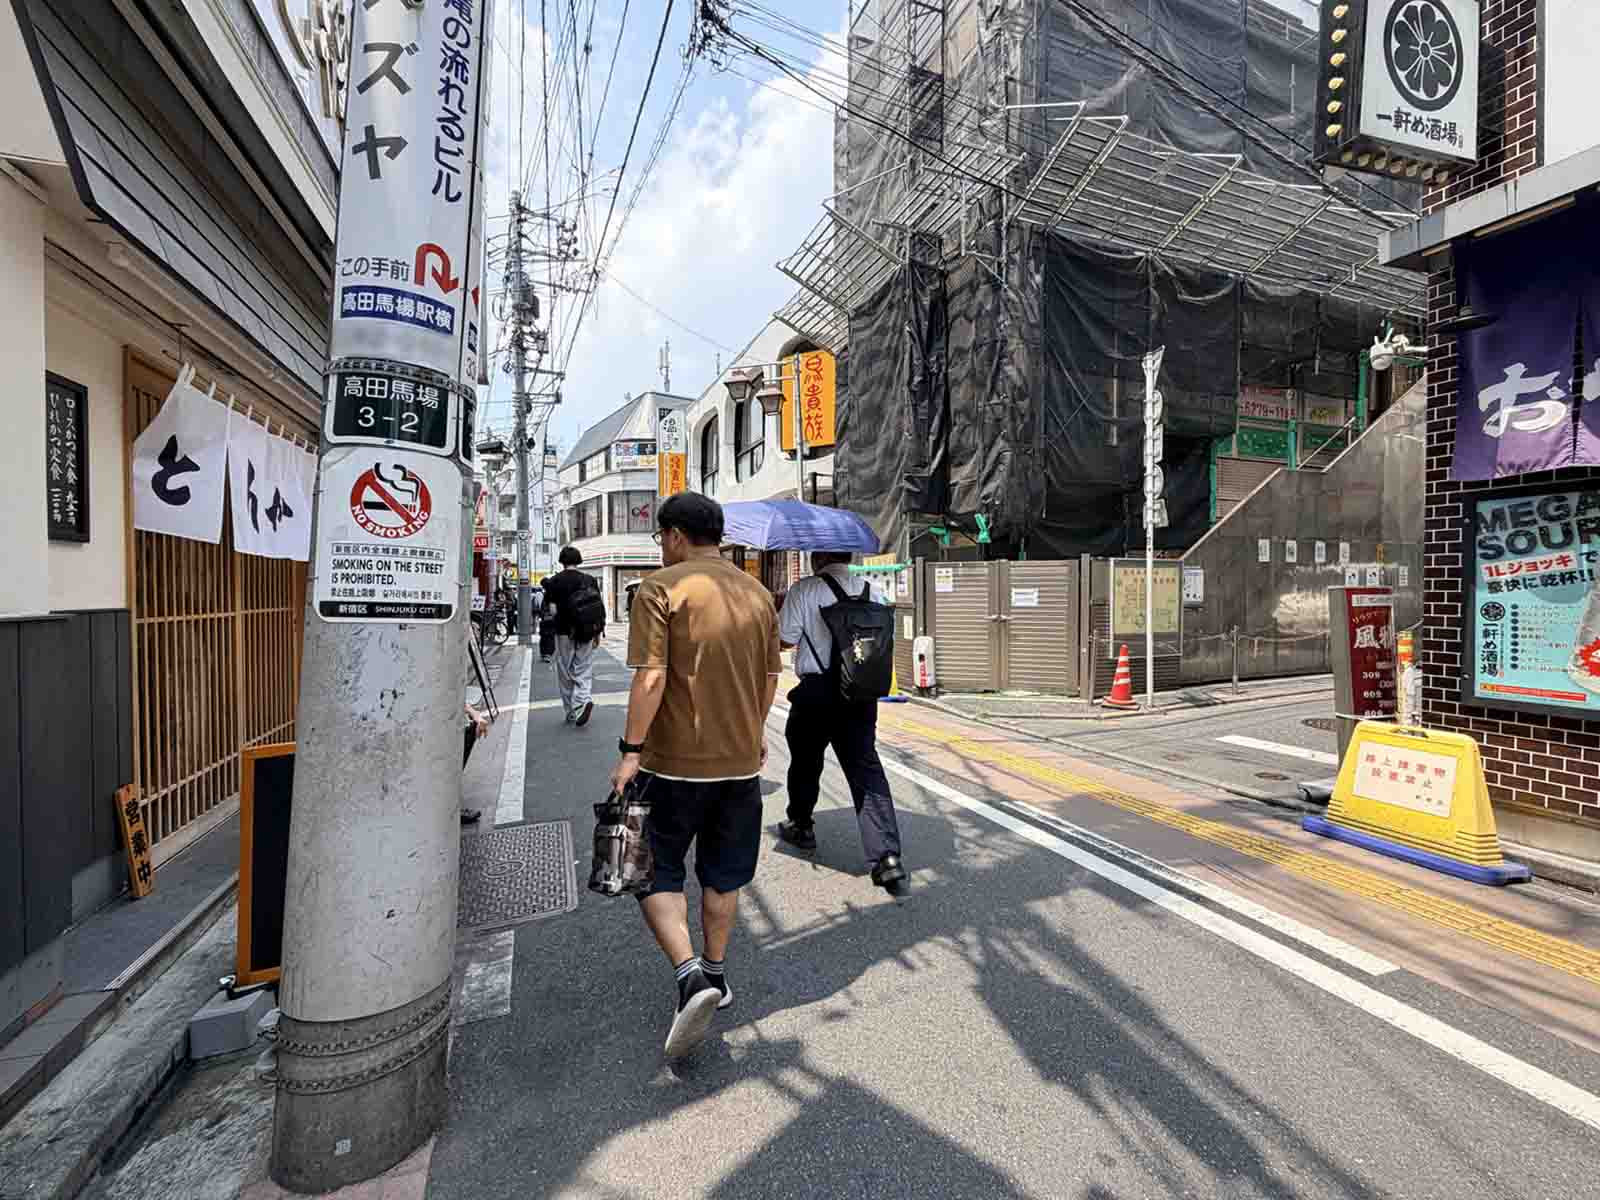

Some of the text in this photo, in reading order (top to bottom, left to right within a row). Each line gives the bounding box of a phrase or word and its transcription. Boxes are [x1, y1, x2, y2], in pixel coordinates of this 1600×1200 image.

[351, 0, 420, 180] ズヤ
[1376, 107, 1458, 146] 一軒め酒場
[341, 256, 410, 282] この手前
[342, 291, 452, 332] 高田馬場駅横
[343, 375, 440, 409] 高田馬場
[357, 406, 419, 433] 3-2
[352, 505, 429, 537] NO SMOKING
[331, 559, 444, 574] SMOKING ON THE STREET
[331, 573, 397, 585] IS PROHIBITED.
[338, 604, 368, 614] 新宿区
[375, 605, 417, 614] SHINJUKU
[1480, 622, 1499, 678] 一軒め酒場
[125, 798, 151, 884] 営業中
